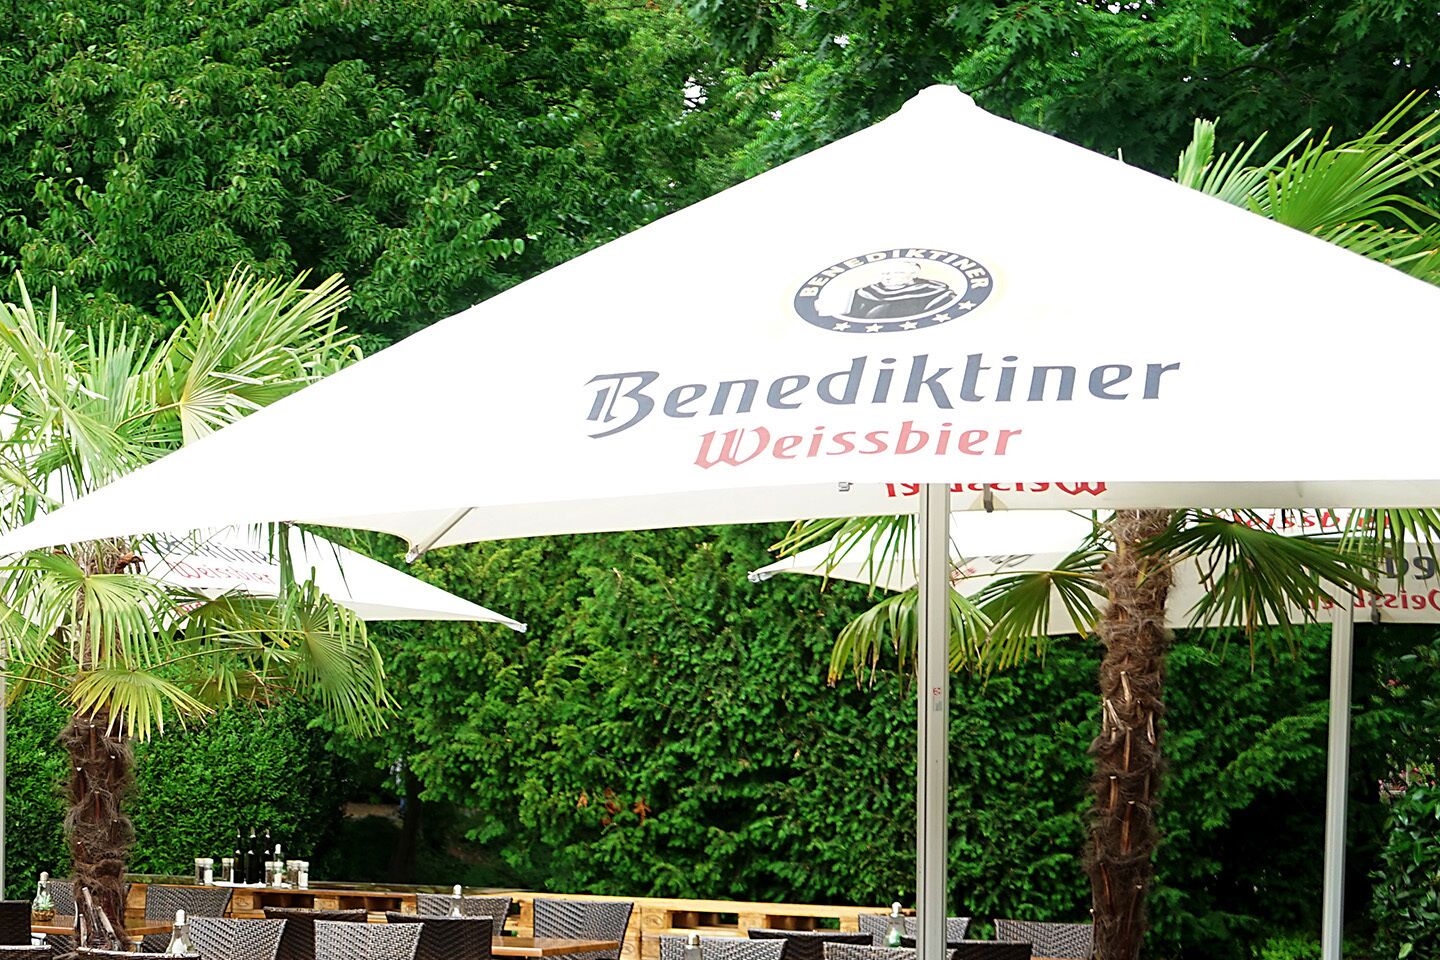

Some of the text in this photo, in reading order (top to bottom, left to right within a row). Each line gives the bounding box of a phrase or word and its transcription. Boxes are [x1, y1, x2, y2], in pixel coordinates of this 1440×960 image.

[799, 248, 990, 297] BENEDIKTINER
[583, 352, 1181, 440] Benediktiner
[692, 420, 1022, 470] Weissbier
